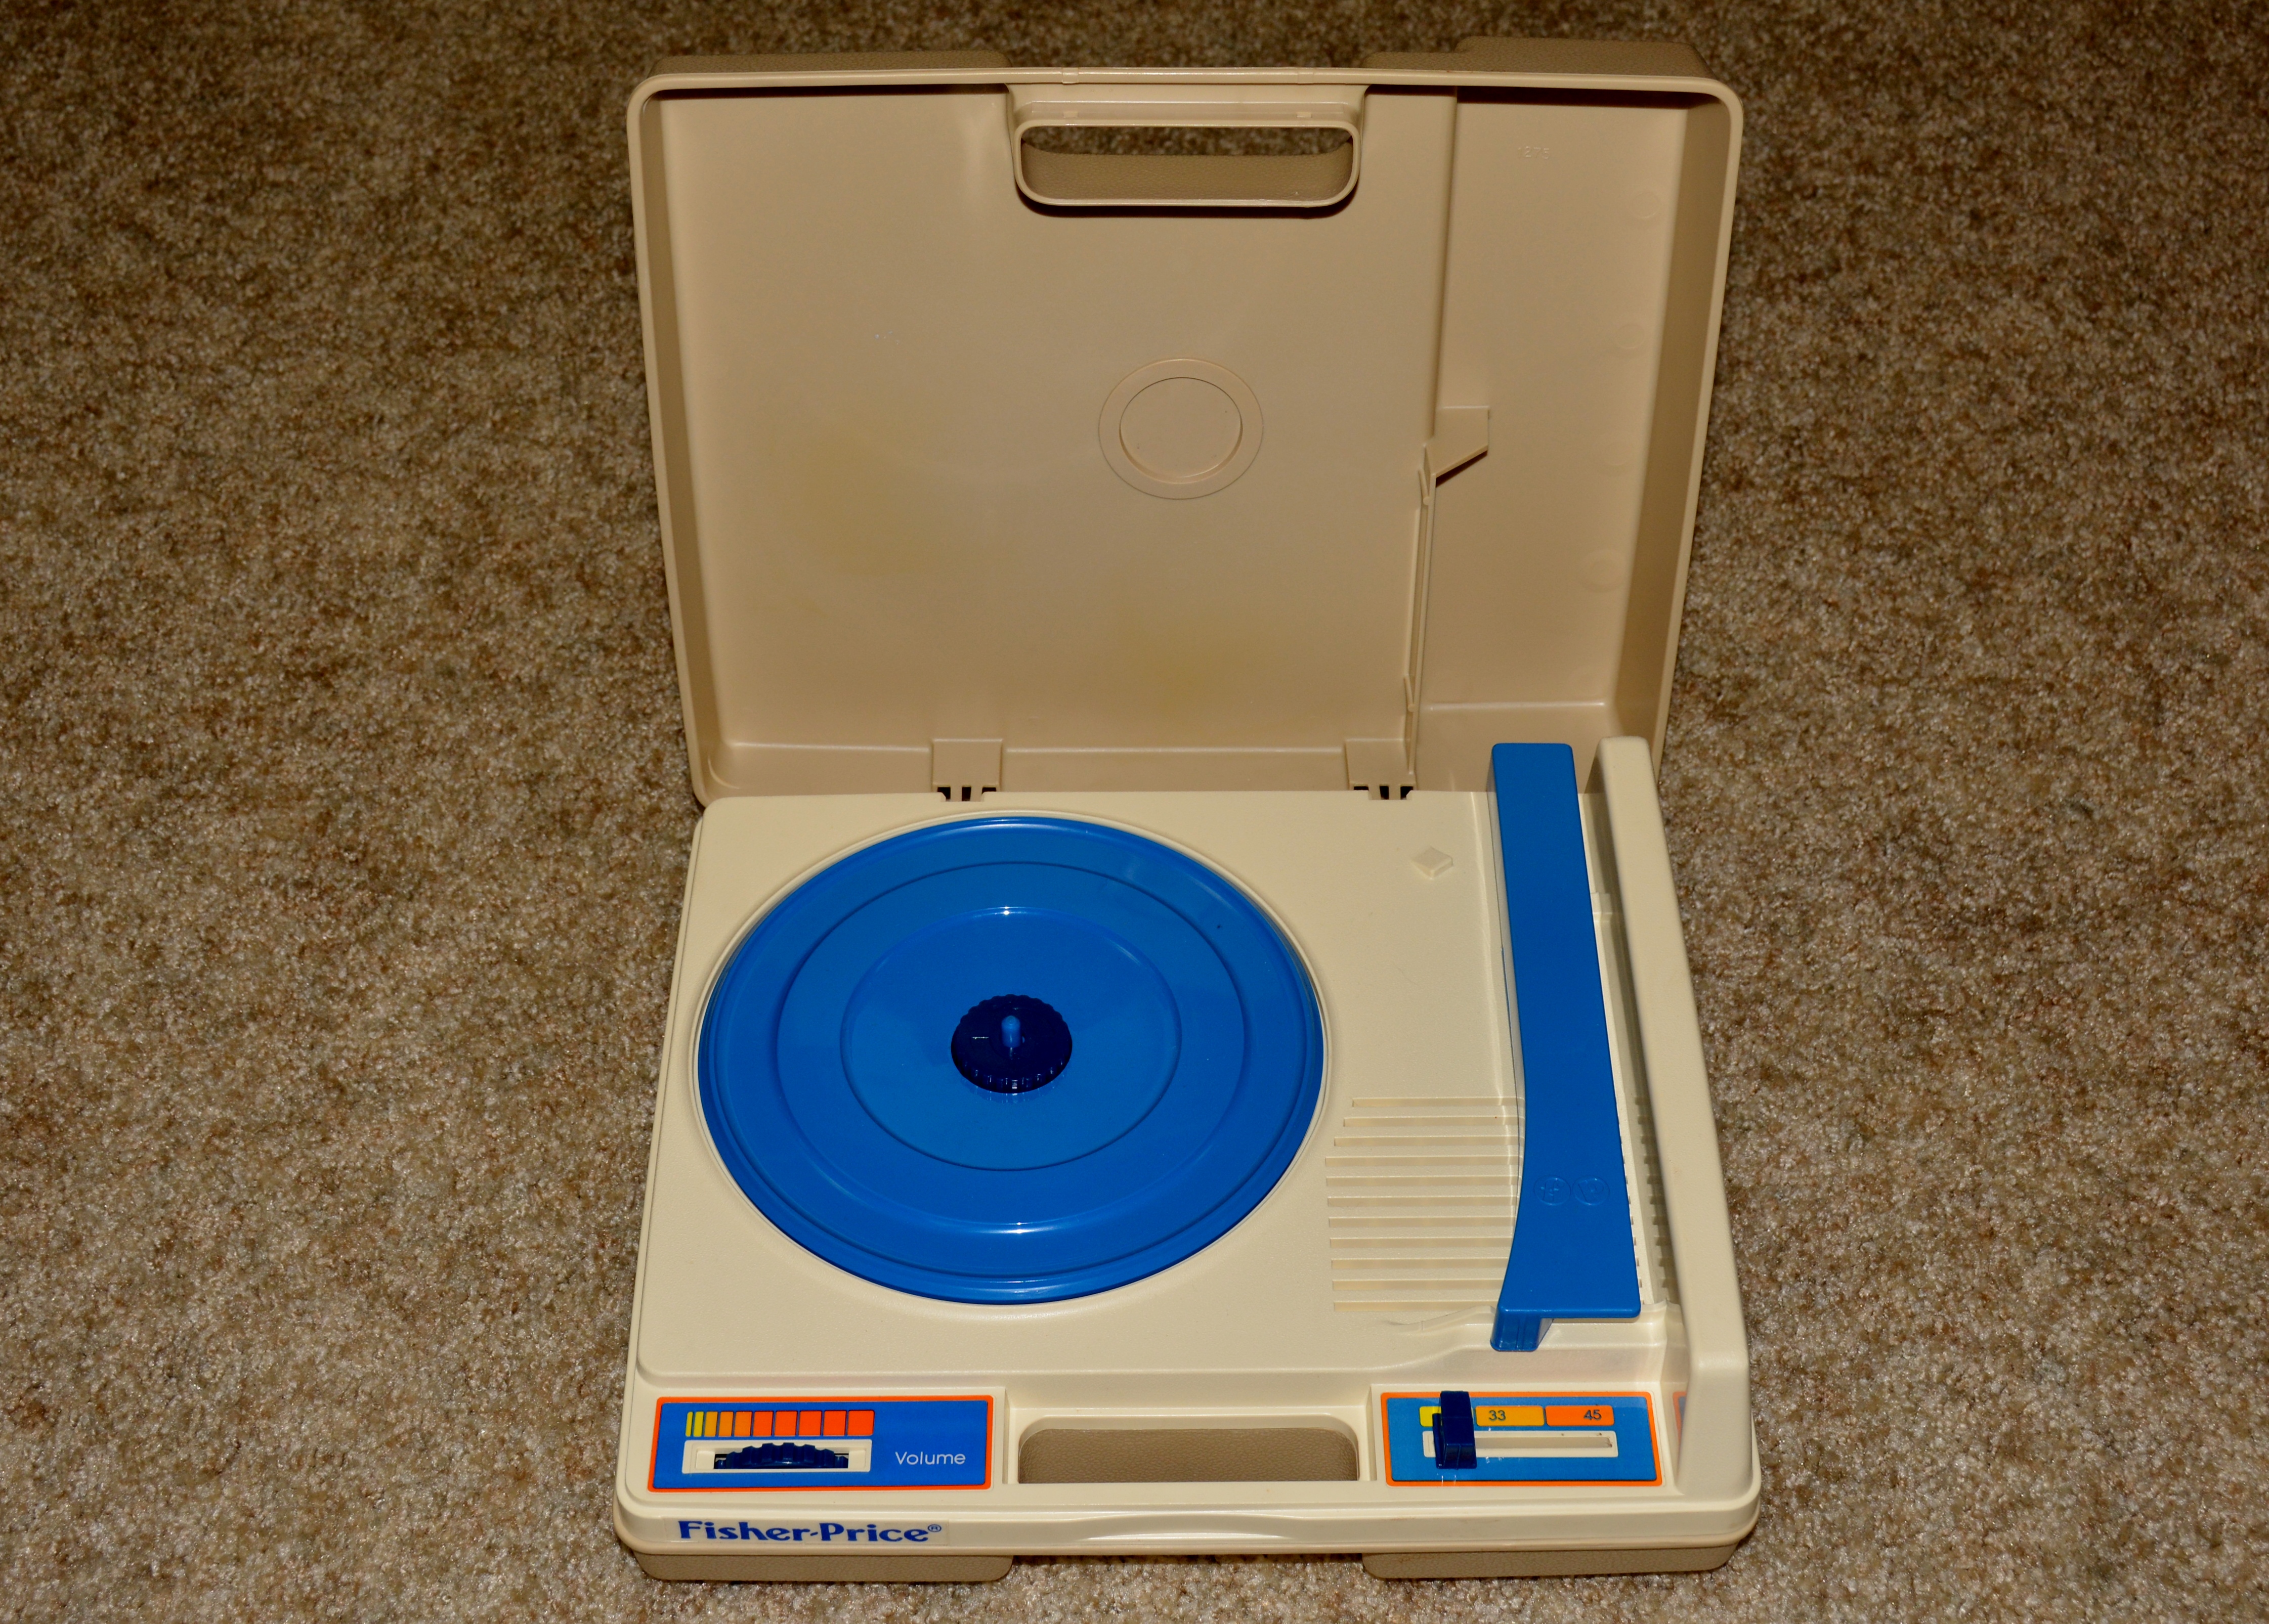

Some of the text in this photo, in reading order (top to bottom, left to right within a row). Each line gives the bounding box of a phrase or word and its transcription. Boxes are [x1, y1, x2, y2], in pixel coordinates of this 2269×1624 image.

[1488, 1410, 1506, 1421] 33
[1583, 1410, 1602, 1421] 45
[895, 1451, 966, 1465] Volume
